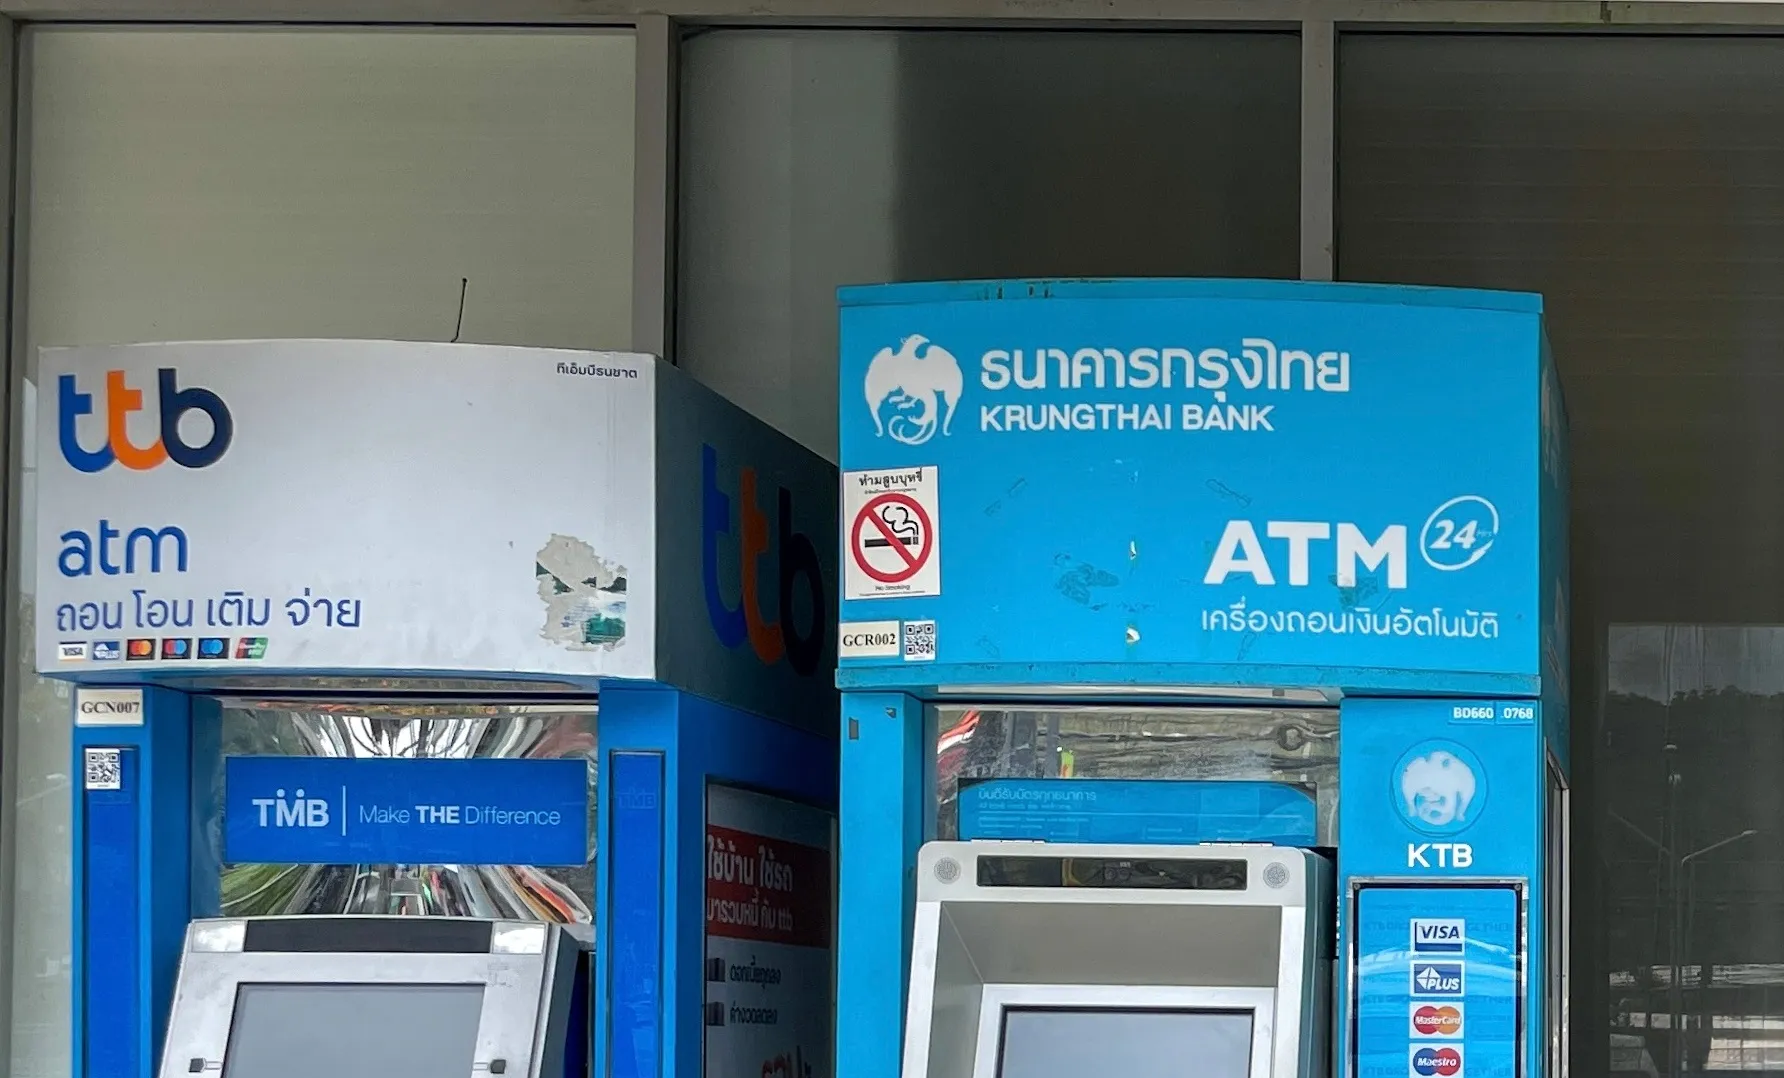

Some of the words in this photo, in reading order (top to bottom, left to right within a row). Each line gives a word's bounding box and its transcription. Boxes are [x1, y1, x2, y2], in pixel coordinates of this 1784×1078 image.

[557, 362, 638, 379] ทีเอ็มบีธนชาต
[981, 338, 1350, 403] ธนาคารกรุงไทย
[58, 367, 234, 473] ttb
[980, 403, 1172, 432] KRUNGTHAI
[1182, 403, 1275, 432] BANK
[57, 519, 189, 577] atm
[702, 442, 826, 678] ttb
[1202, 520, 1408, 590] ATM
[1428, 519, 1479, 550] 24
[56, 601, 123, 632] ถอน
[131, 589, 194, 629] โอน
[207, 591, 272, 628] เติม
[285, 587, 362, 628] จ่าย
[1202, 596, 1499, 638] เครื่องถอนเงินอัตโนมัติ
[842, 633, 897, 647] GCR002
[80, 700, 141, 715] GCN007
[252, 788, 330, 828] TMB
[358, 804, 411, 825] Make
[415, 804, 461, 825] THE
[465, 804, 561, 826] Difference
[1407, 843, 1473, 868] KTB
[1419, 925, 1461, 940] VISA
[1427, 975, 1460, 991] PLUS
[1417, 1056, 1457, 1068] Maestro
